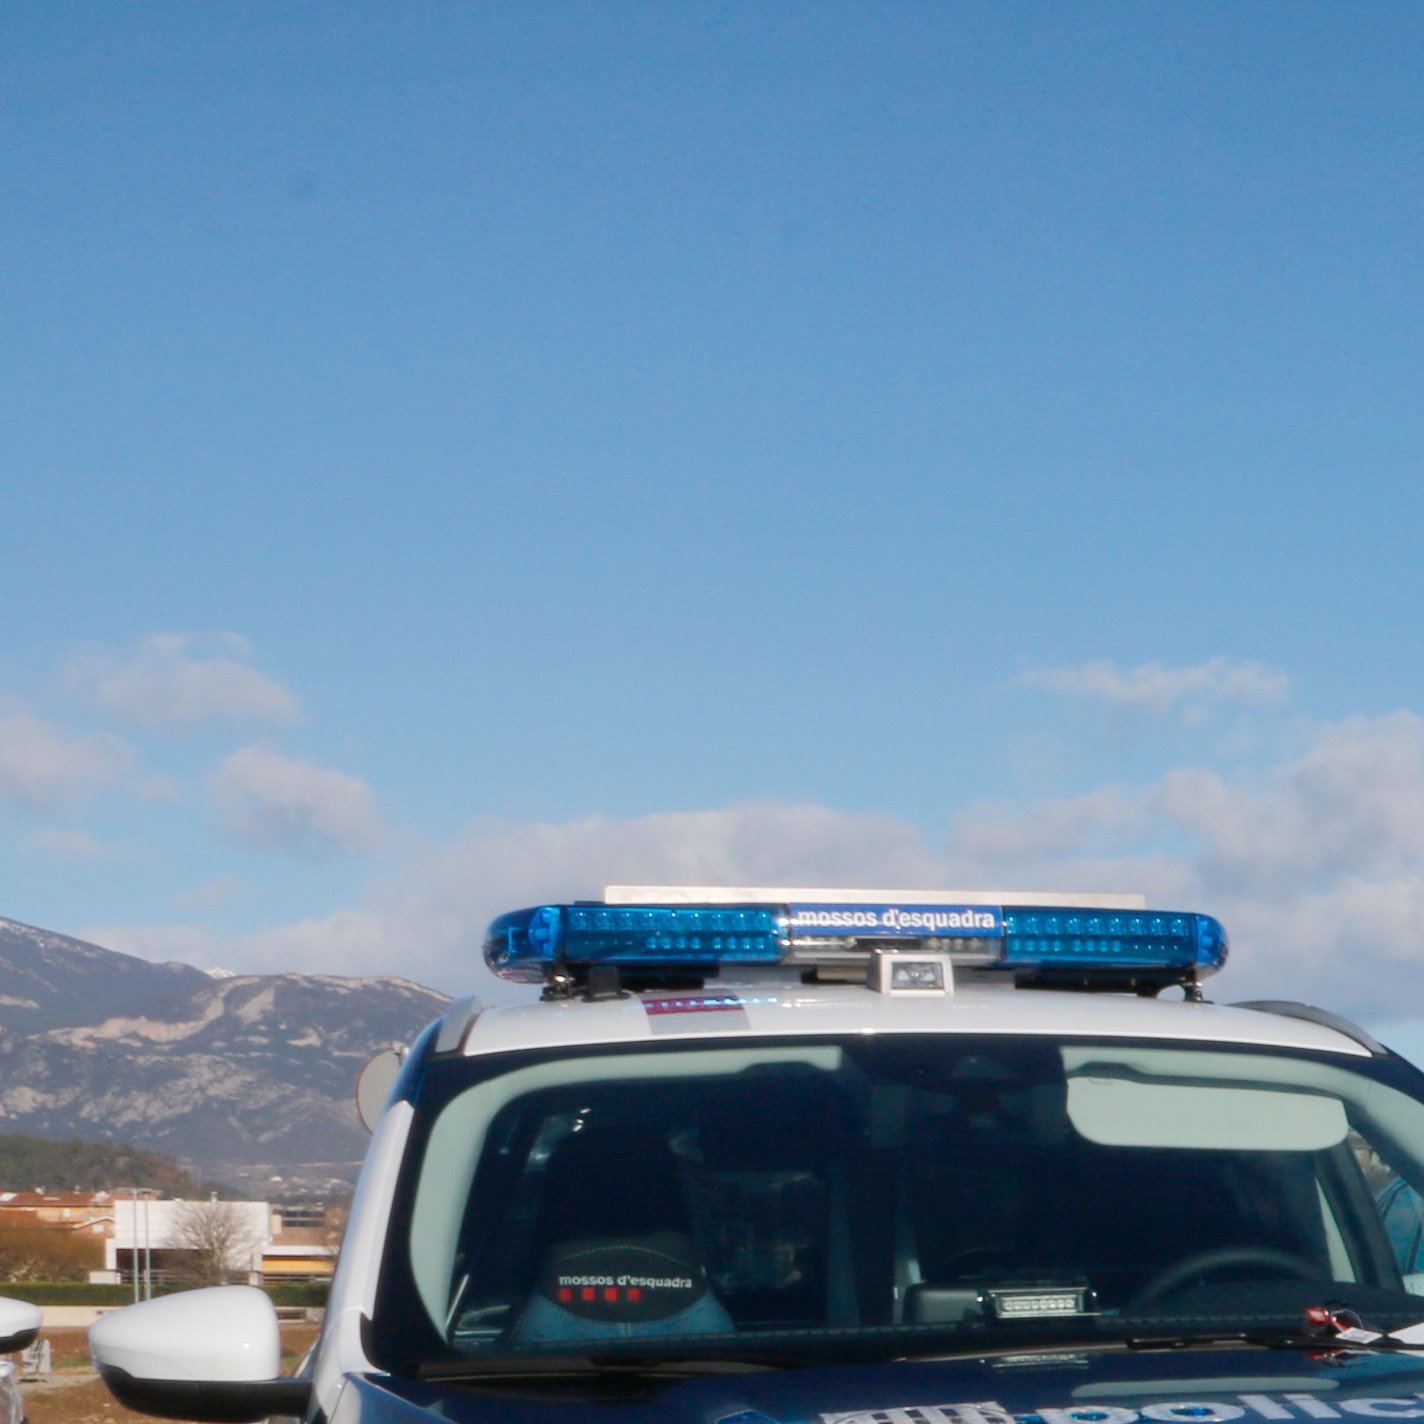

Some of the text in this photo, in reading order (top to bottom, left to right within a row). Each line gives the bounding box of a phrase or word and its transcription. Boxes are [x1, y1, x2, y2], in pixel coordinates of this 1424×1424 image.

[797, 908, 996, 931] mossos d'esquadra
[558, 1274, 693, 1289] mossos d'esquadra
